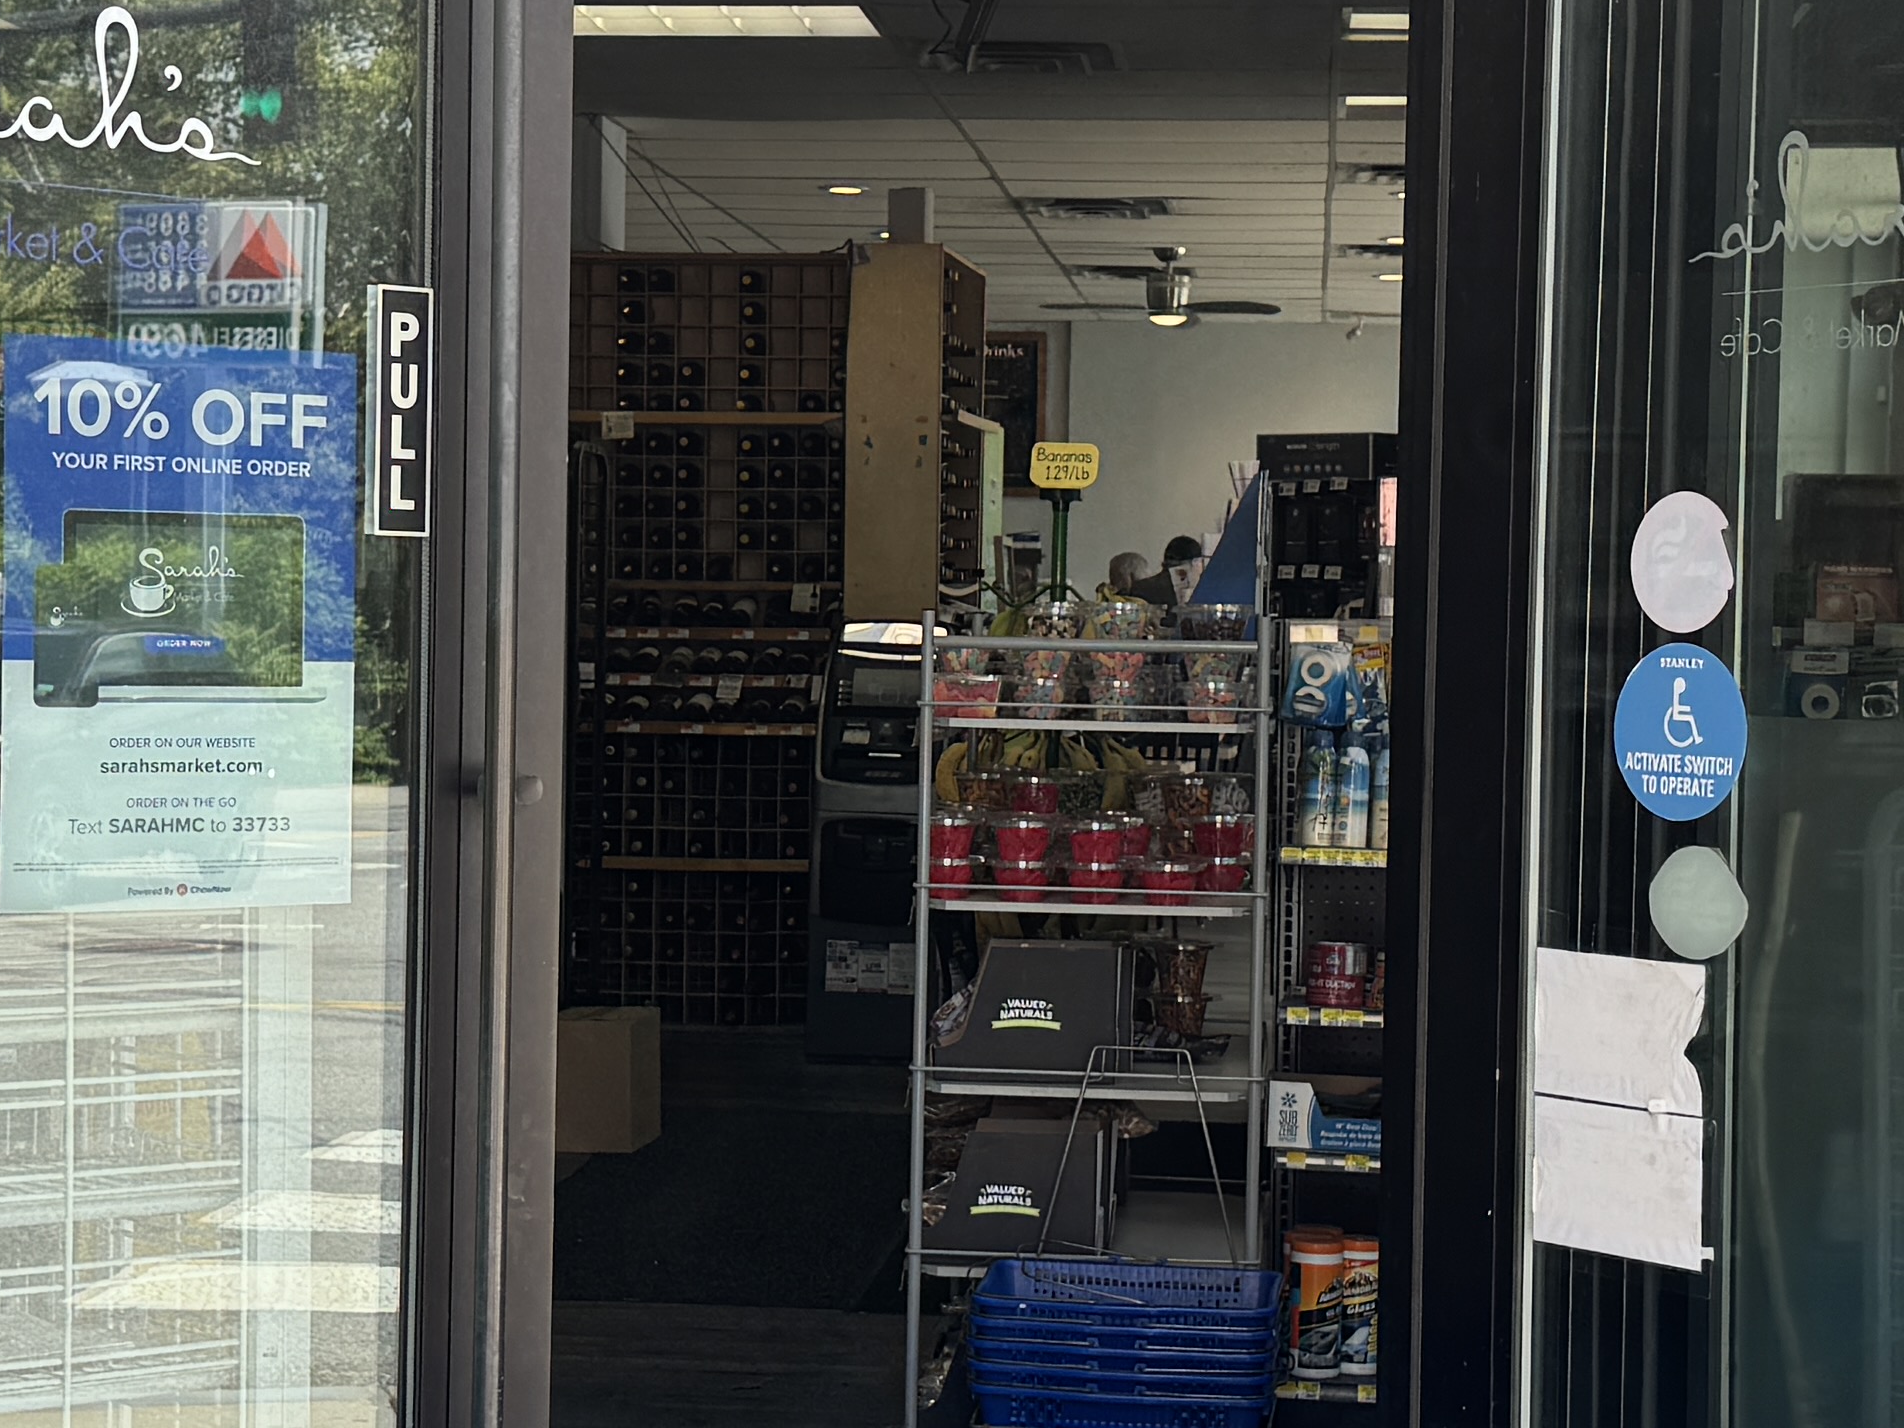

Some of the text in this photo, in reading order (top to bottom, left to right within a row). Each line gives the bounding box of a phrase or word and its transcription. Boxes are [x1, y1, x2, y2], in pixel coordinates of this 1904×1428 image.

[73, 222, 104, 265] &
[984, 344, 1024, 358] rinks
[34, 377, 328, 449] 10% OFF
[389, 310, 419, 511] PULL
[52, 451, 311, 478] YOUR FIRST ONLINE ORDER
[1036, 447, 1093, 464] Bananas
[132, 546, 245, 588] Sarah's
[109, 737, 256, 749] ORDER ON OUR WEBSITE
[100, 758, 263, 774] sarahsmarket.com
[1624, 752, 1734, 777] ACTIVATE SWITCH
[1642, 774, 1715, 798] TO OPERATE
[126, 797, 237, 809] ORDER ON THE GO
[68, 816, 291, 835] Text SARAHMC to 33733
